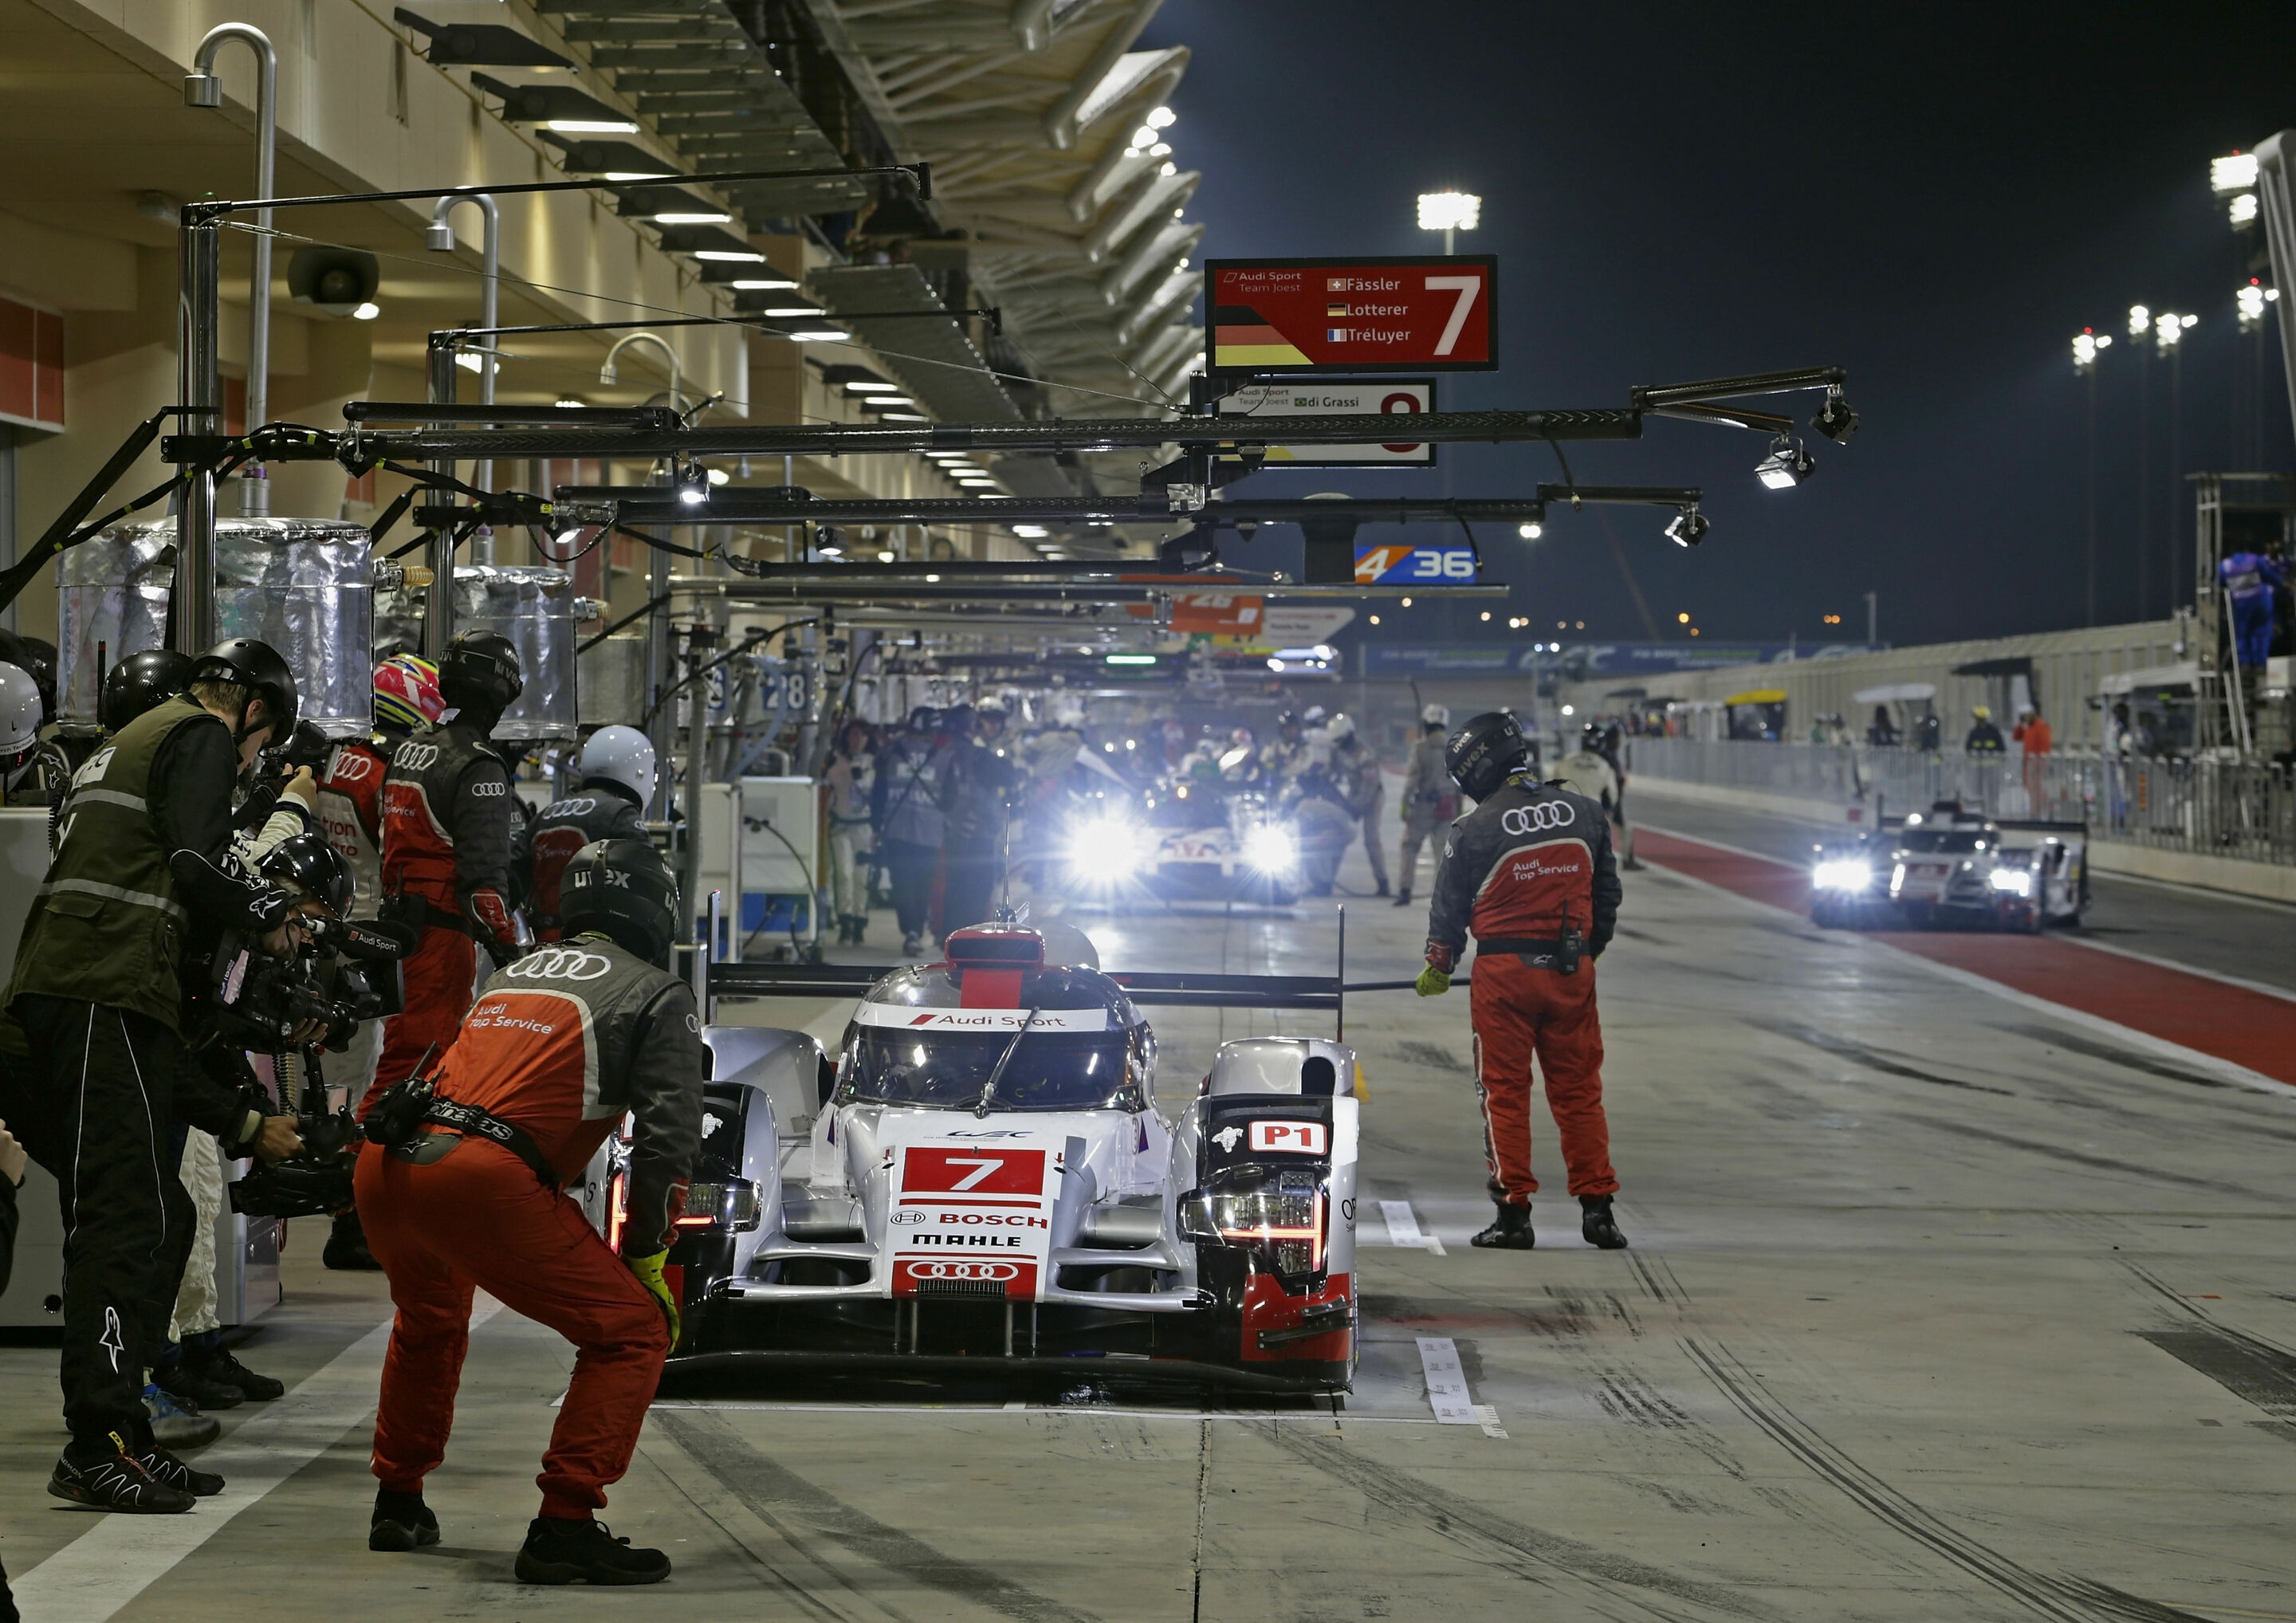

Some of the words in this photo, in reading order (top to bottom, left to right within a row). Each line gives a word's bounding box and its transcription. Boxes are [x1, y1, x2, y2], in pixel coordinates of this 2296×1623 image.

[1239, 272, 1265, 281] Audi
[1268, 272, 1302, 281] Sport
[1347, 277, 1401, 291] Fässler
[1240, 284, 1269, 293] Team
[1273, 284, 1300, 293] Joest
[1347, 303, 1409, 316] Lotterer
[1425, 275, 1480, 356] 7
[1347, 328, 1411, 344] Tréluyer
[1307, 398, 1319, 407] di
[1323, 397, 1359, 407] Grassi
[1413, 550, 1474, 578] 36
[766, 674, 806, 710] 28
[1453, 730, 1472, 753] uvex
[1457, 741, 1489, 777] uvex
[1512, 858, 1540, 872] Audi
[1513, 870, 1535, 881] Top
[1537, 864, 1578, 875] Service
[358, 933, 375, 945] Audi
[375, 939, 397, 952] Sport
[476, 1003, 507, 1018] Audi
[492, 1016, 552, 1034] Service
[938, 1015, 993, 1025] Audi
[1001, 1016, 1067, 1028] Sport
[1264, 1126, 1312, 1147] P1
[945, 1157, 1005, 1191] 7
[938, 1212, 1048, 1230] BOSCH
[912, 1234, 1021, 1248] MAHLE
